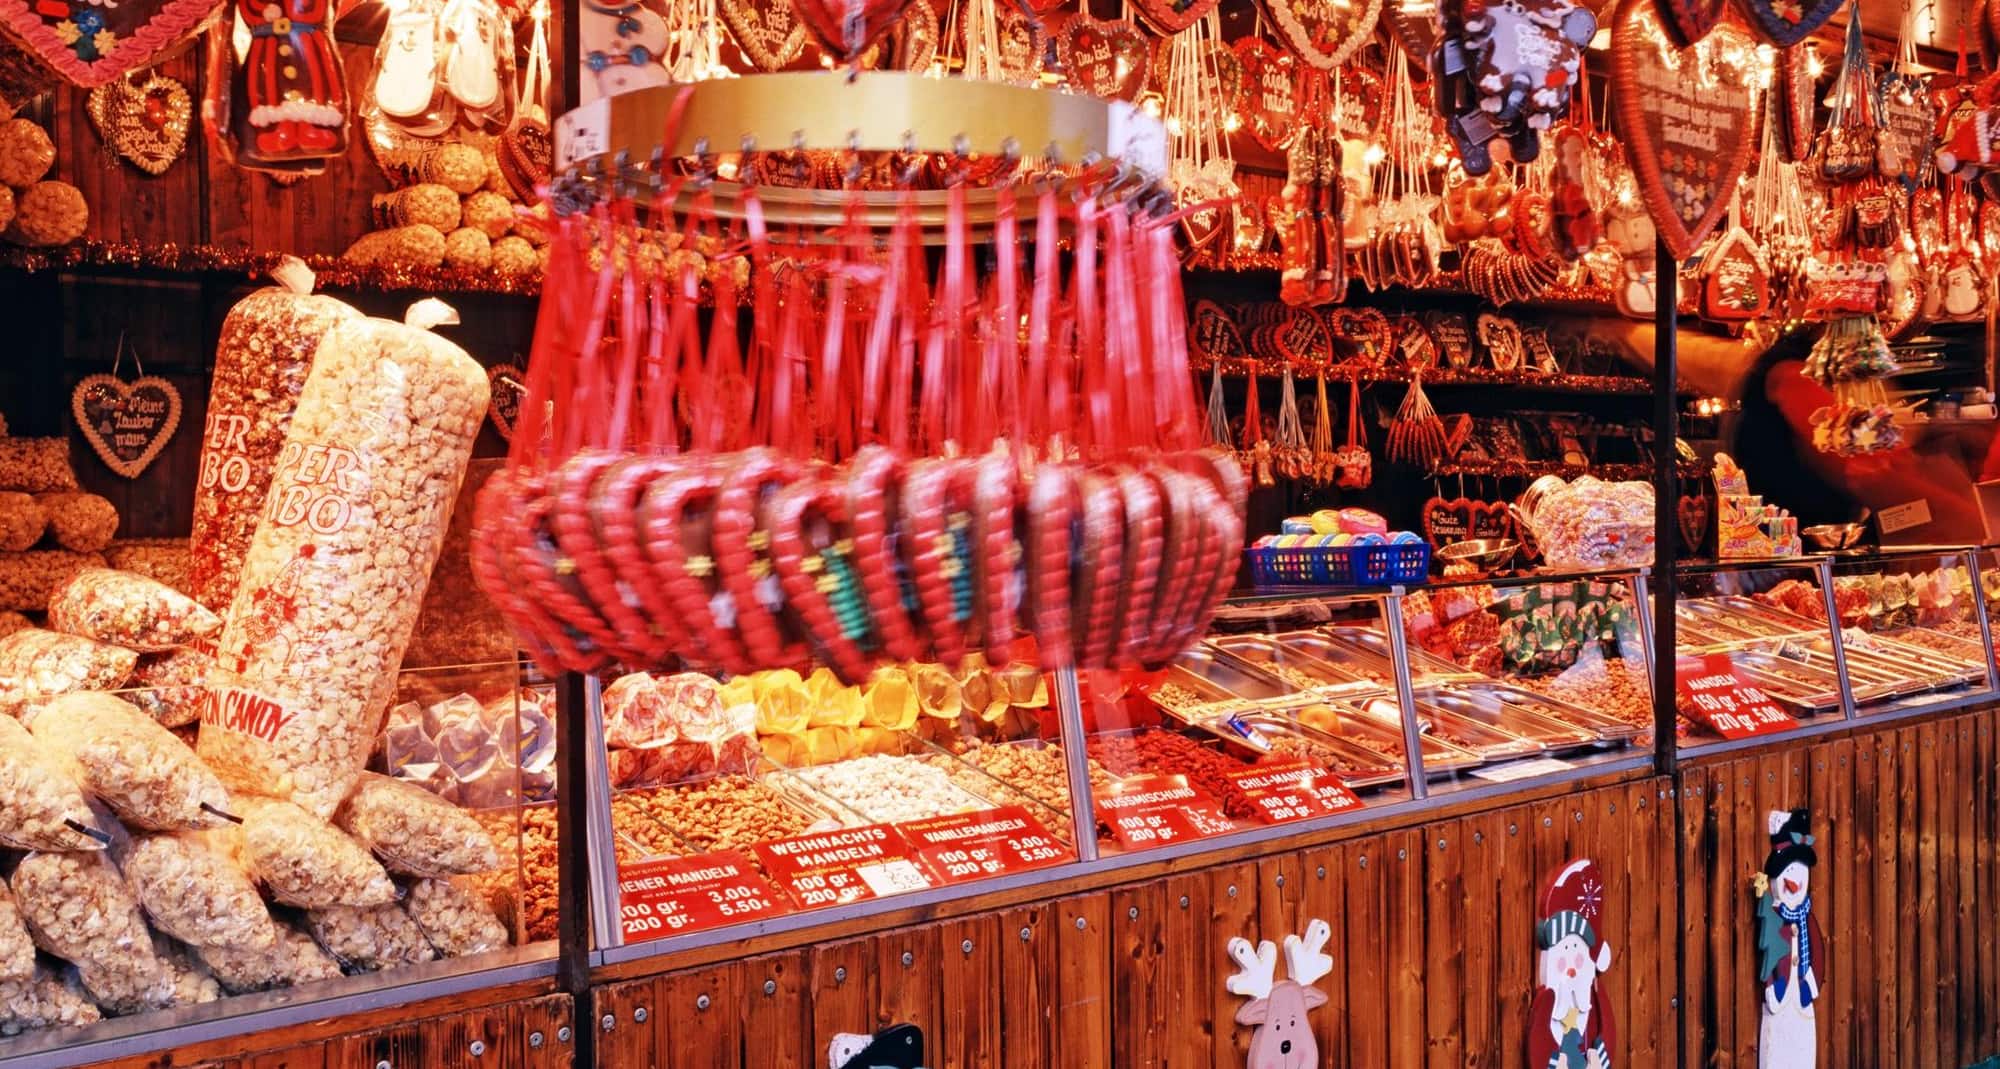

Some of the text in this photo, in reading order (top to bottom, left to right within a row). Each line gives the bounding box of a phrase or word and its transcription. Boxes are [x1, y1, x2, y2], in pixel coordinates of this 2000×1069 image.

[1075, 51, 1093, 66] Du
[1093, 63, 1109, 80] die
[128, 396, 165, 414] Meine
[1438, 511, 1459, 525] Gute
[1686, 674, 1738, 690] MANDELN
[224, 690, 298, 743] CANDY
[1237, 767, 1328, 789] CHILI-MANDELN
[1099, 787, 1196, 809] NUSSMISCHUNG
[1259, 796, 1284, 808] 100
[1284, 795, 1303, 806] gr.
[1270, 807, 1295, 820] 200
[1295, 805, 1314, 817] gr.
[923, 819, 1027, 842] VANILLEMANDELN
[1118, 816, 1145, 829] 100
[1146, 816, 1167, 827] gr.
[769, 828, 887, 856] WEIHNACHTS
[1127, 829, 1156, 842] 200
[1157, 827, 1178, 839] gr.
[795, 844, 884, 867] MANDELN
[937, 850, 968, 864] 100
[971, 848, 994, 861] gr.
[668, 865, 739, 886] MANDELN
[947, 862, 979, 876] 200
[982, 859, 1005, 873] gr.
[792, 872, 855, 891] 100 gr.
[656, 900, 685, 915] gr.
[708, 886, 760, 903] 3.00€
[801, 888, 836, 905] 200
[623, 898, 773, 933] 200 gr. 5.50€
